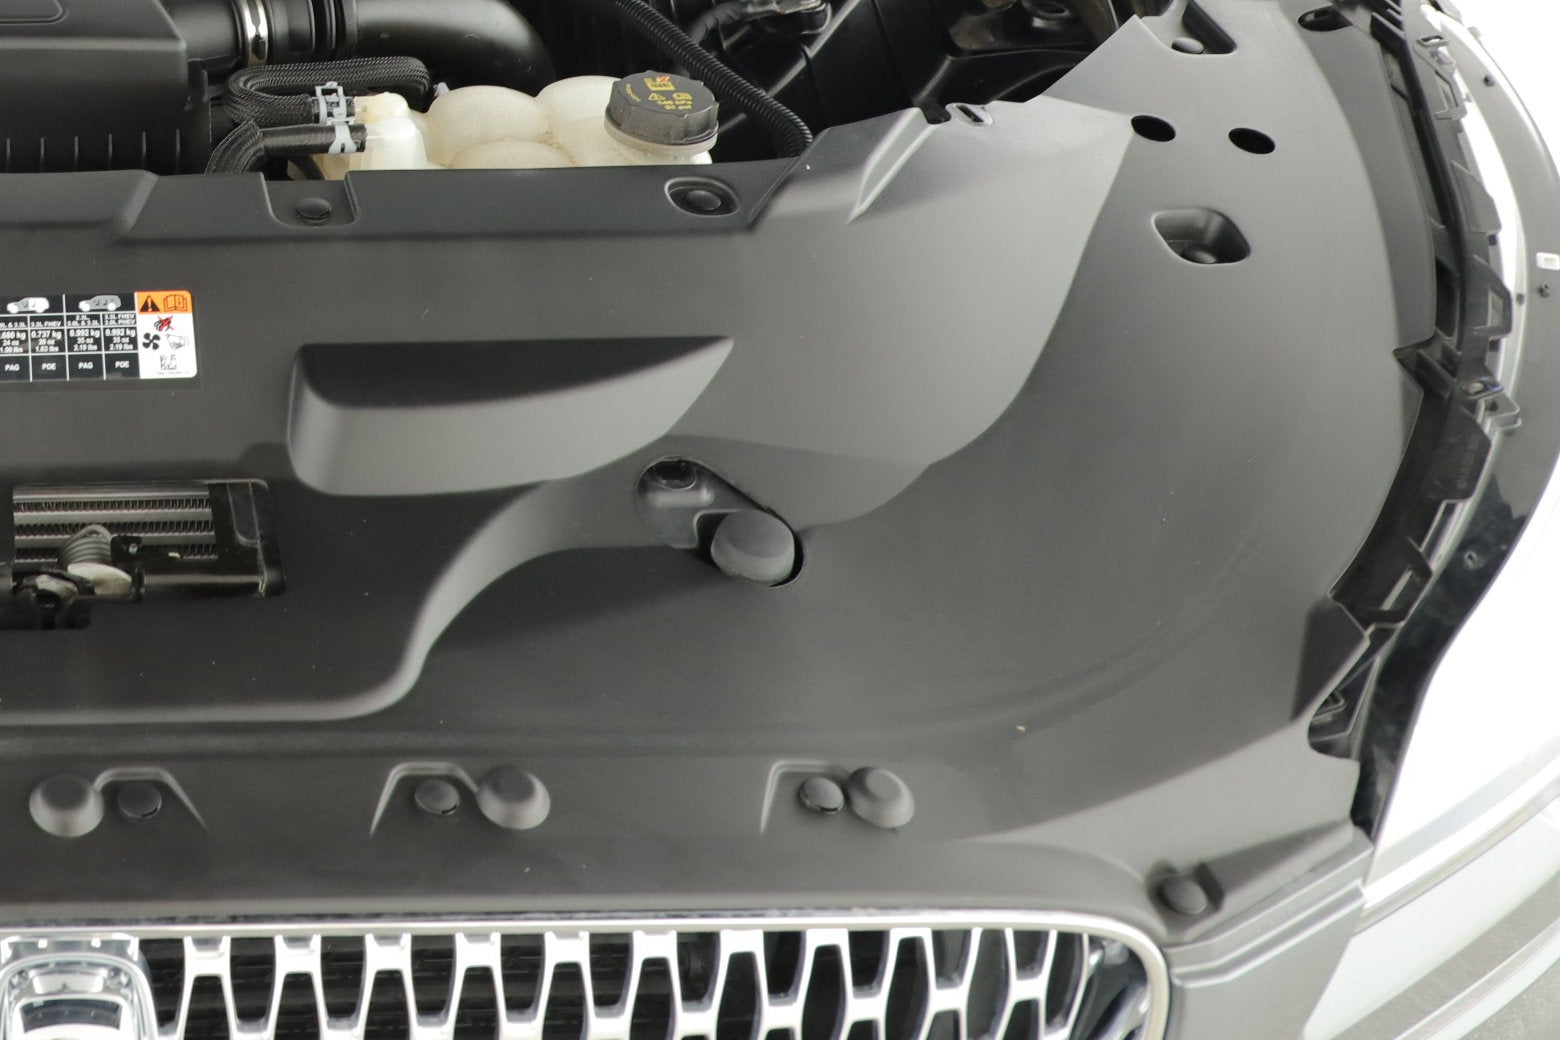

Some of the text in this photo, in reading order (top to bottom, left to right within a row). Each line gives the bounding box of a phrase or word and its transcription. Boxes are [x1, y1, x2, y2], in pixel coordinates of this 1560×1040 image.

[16, 331, 26, 340] kg
[31, 330, 62, 339] 0.737 kg
[90, 329, 100, 338] kg
[126, 328, 136, 337] kg
